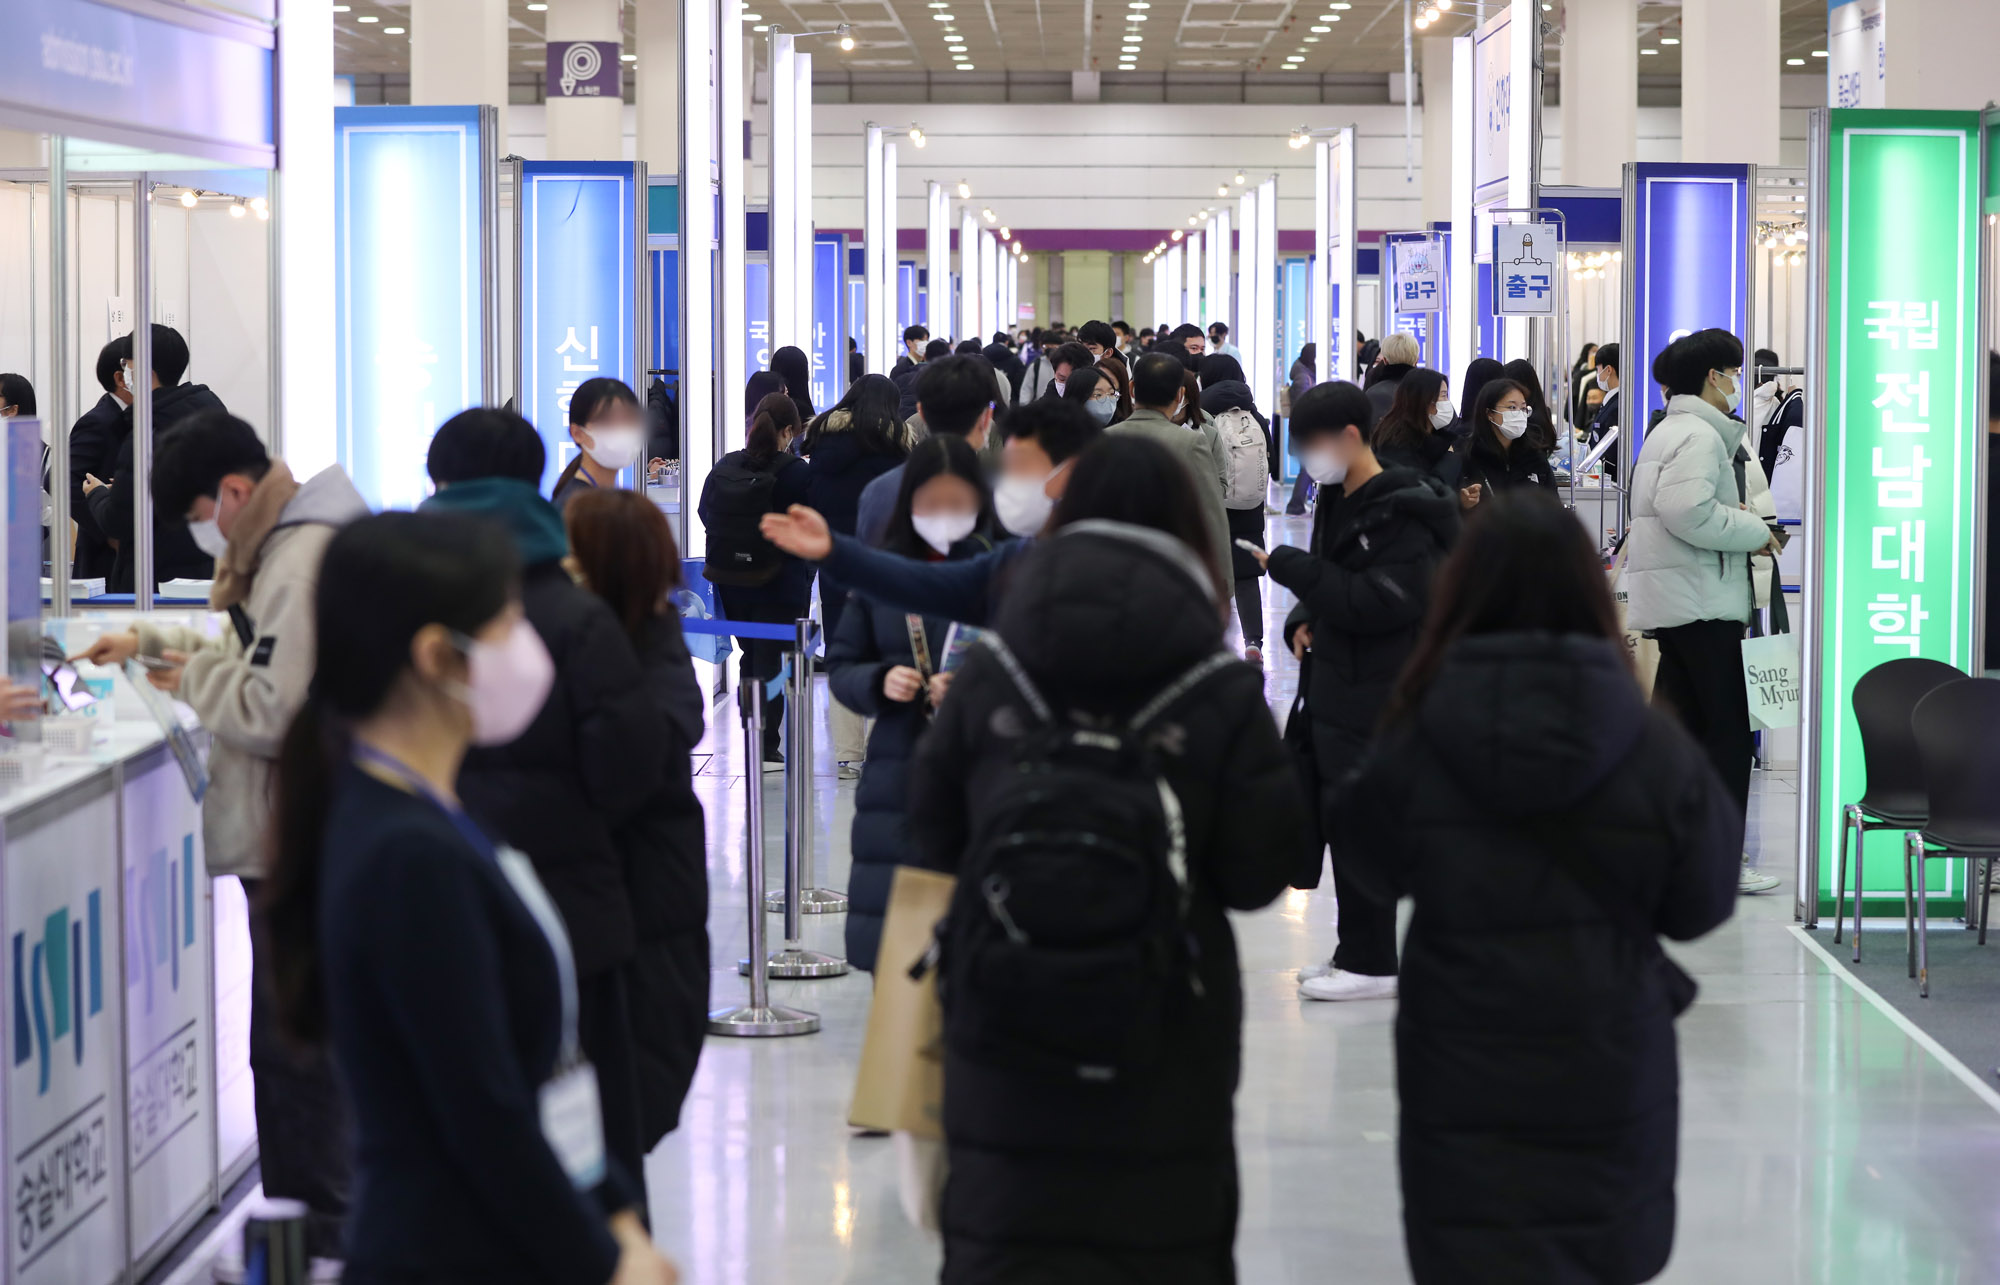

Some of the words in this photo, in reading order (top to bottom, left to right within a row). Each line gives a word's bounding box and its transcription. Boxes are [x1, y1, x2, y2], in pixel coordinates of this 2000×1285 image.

[1404, 281, 1437, 300] 입구
[1506, 274, 1550, 299] 출구
[1863, 300, 1940, 350] 국립
[1747, 664, 1788, 688] Sang
[131, 1038, 198, 1156] 숭실대학교
[15, 1115, 108, 1253] 숭실대학교
